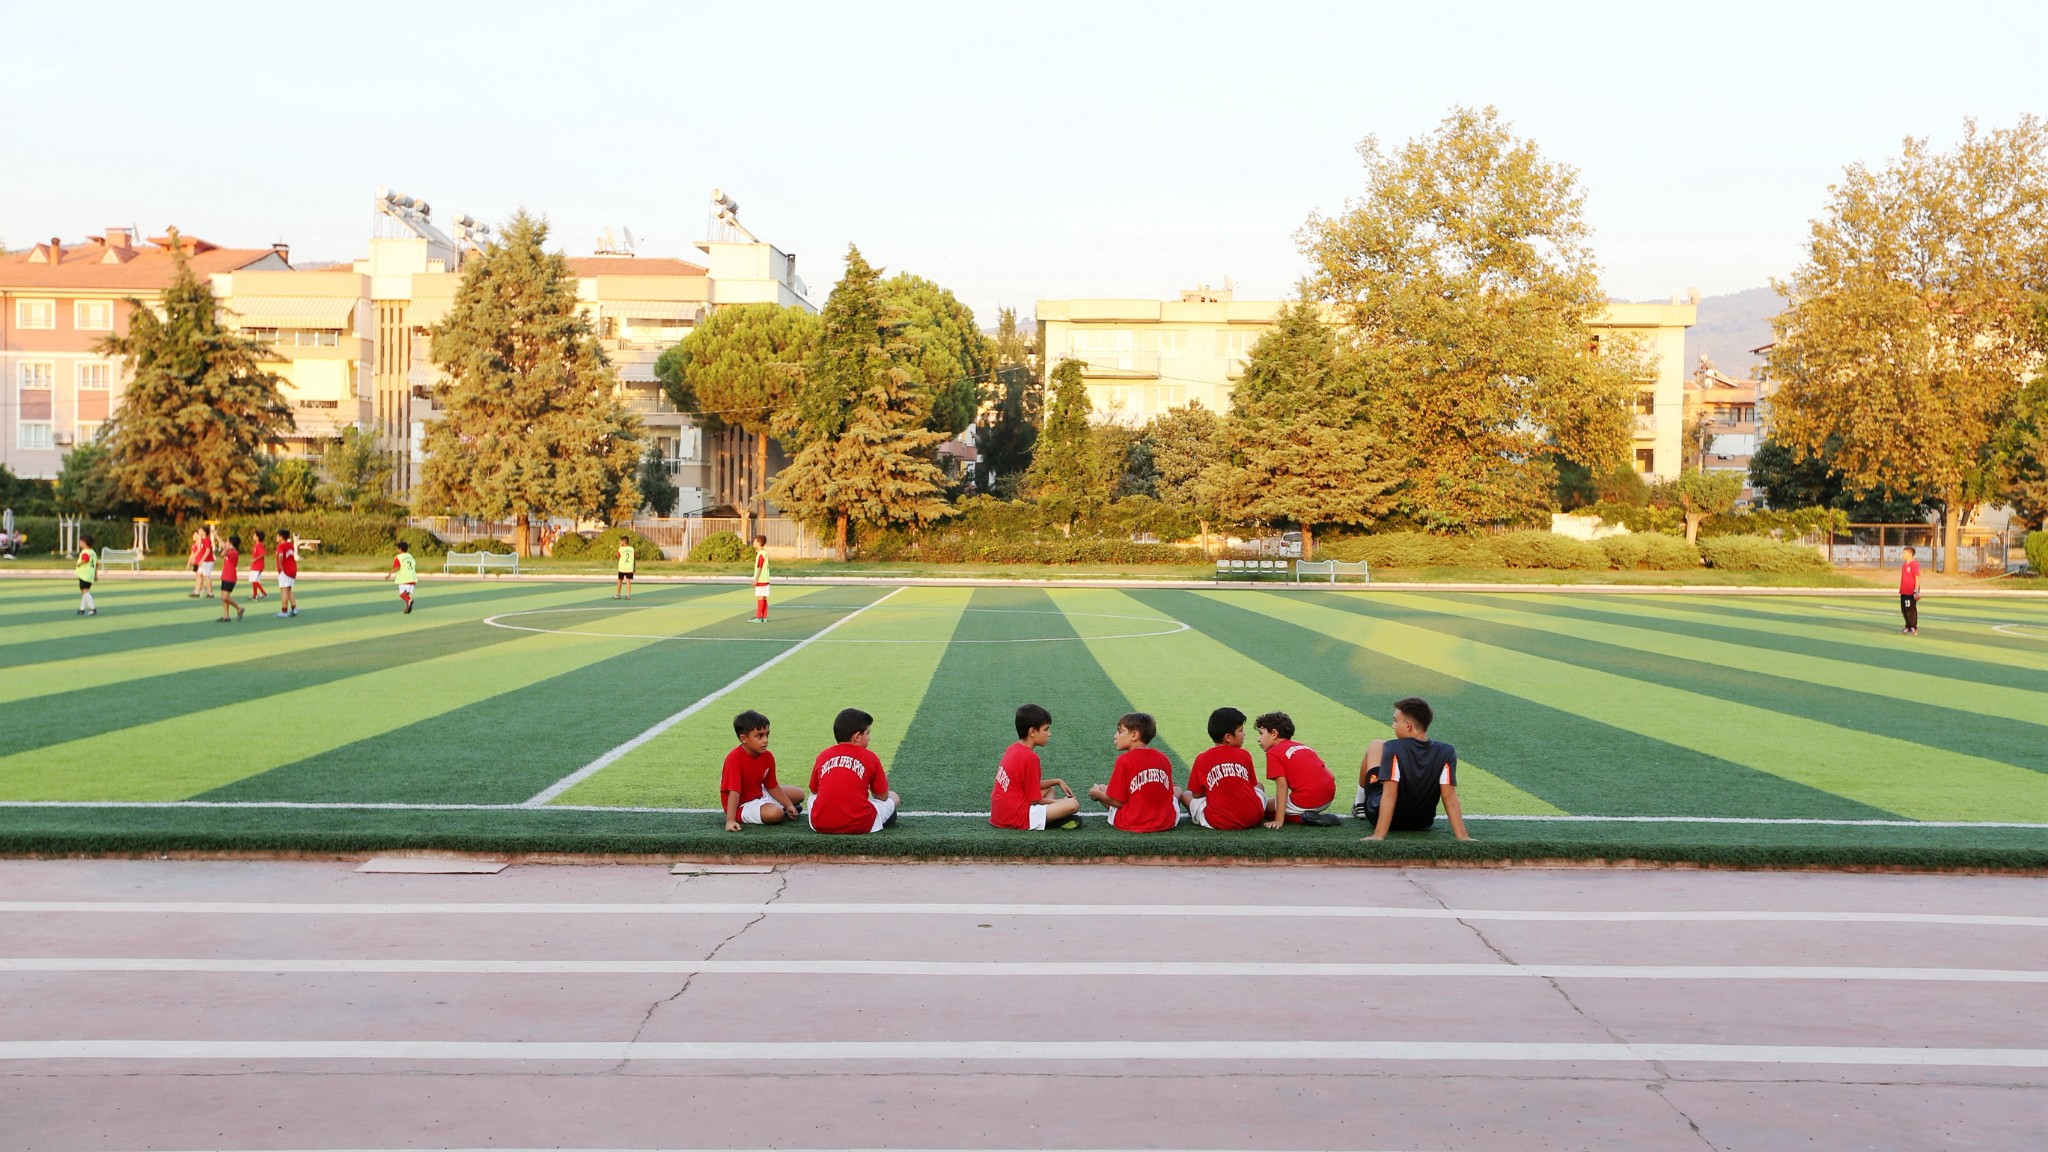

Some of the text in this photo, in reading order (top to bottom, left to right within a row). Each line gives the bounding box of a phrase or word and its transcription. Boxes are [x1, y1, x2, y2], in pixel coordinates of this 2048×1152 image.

[625, 552, 630, 563] 2
[838, 755, 854, 770] EFES
[852, 758, 865, 780] SPOR
[1147, 768, 1160, 782] EFES
[1220, 763, 1236, 777] EFES
[1234, 763, 1249, 782] SPOR
